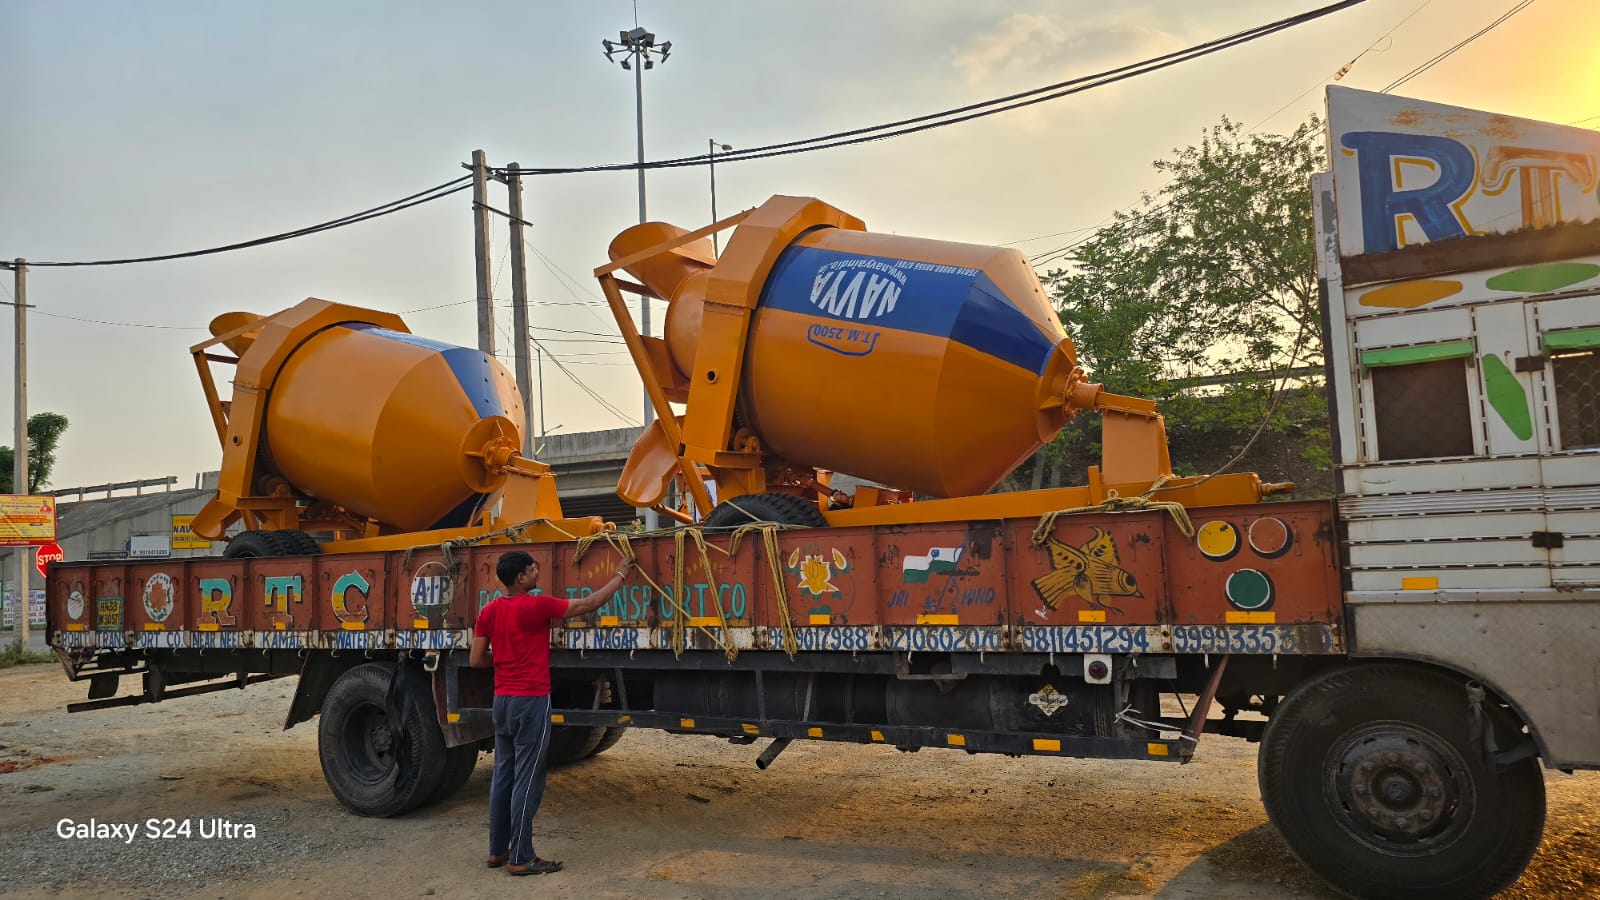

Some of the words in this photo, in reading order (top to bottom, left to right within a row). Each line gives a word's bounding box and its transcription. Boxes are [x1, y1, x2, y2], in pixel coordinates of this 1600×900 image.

[1341, 131, 1600, 255] RT
[809, 271, 901, 318] NAVYA
[174, 526, 192, 534] NAV
[38, 553, 62, 565] STOP
[192, 631, 216, 648] NEAR
[396, 631, 426, 649] SHOP
[594, 628, 639, 649] NAGAR
[769, 627, 868, 651] 989017988
[1022, 626, 1149, 652] 9811451294
